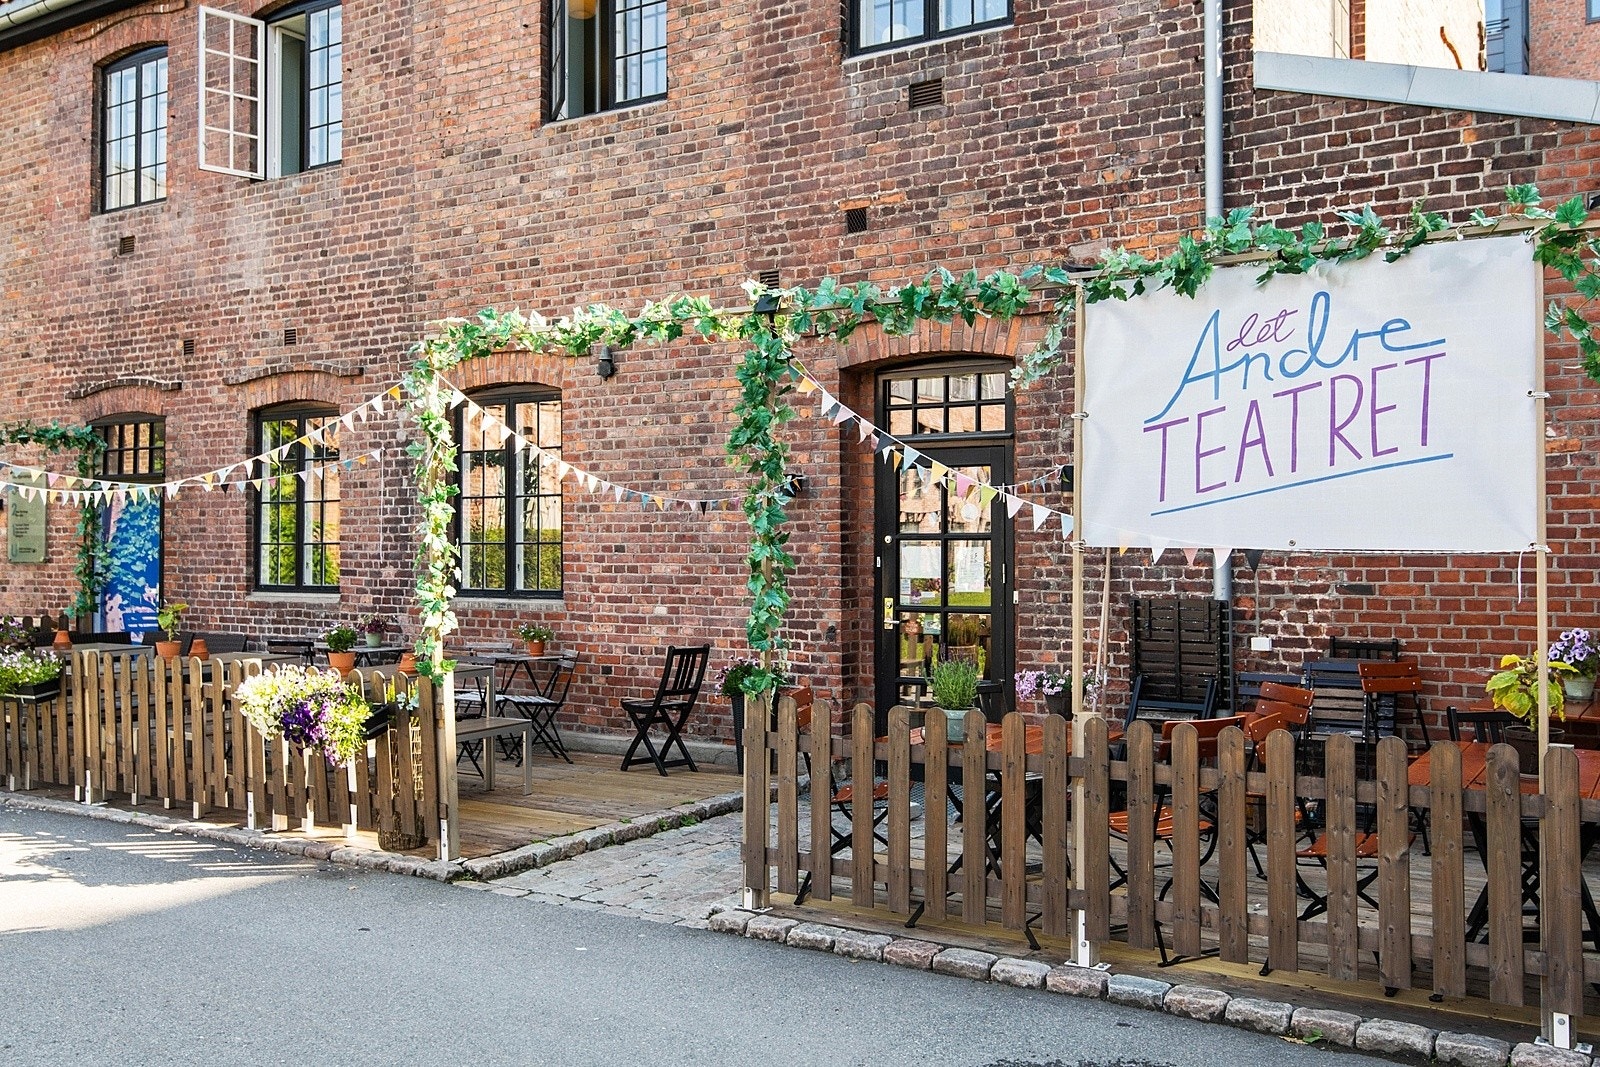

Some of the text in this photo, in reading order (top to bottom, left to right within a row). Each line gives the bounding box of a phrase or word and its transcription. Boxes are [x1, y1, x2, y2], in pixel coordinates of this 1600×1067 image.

[1144, 291, 1446, 424] Andre
[1227, 309, 1298, 352] det
[1143, 352, 1446, 502] TEATRET
